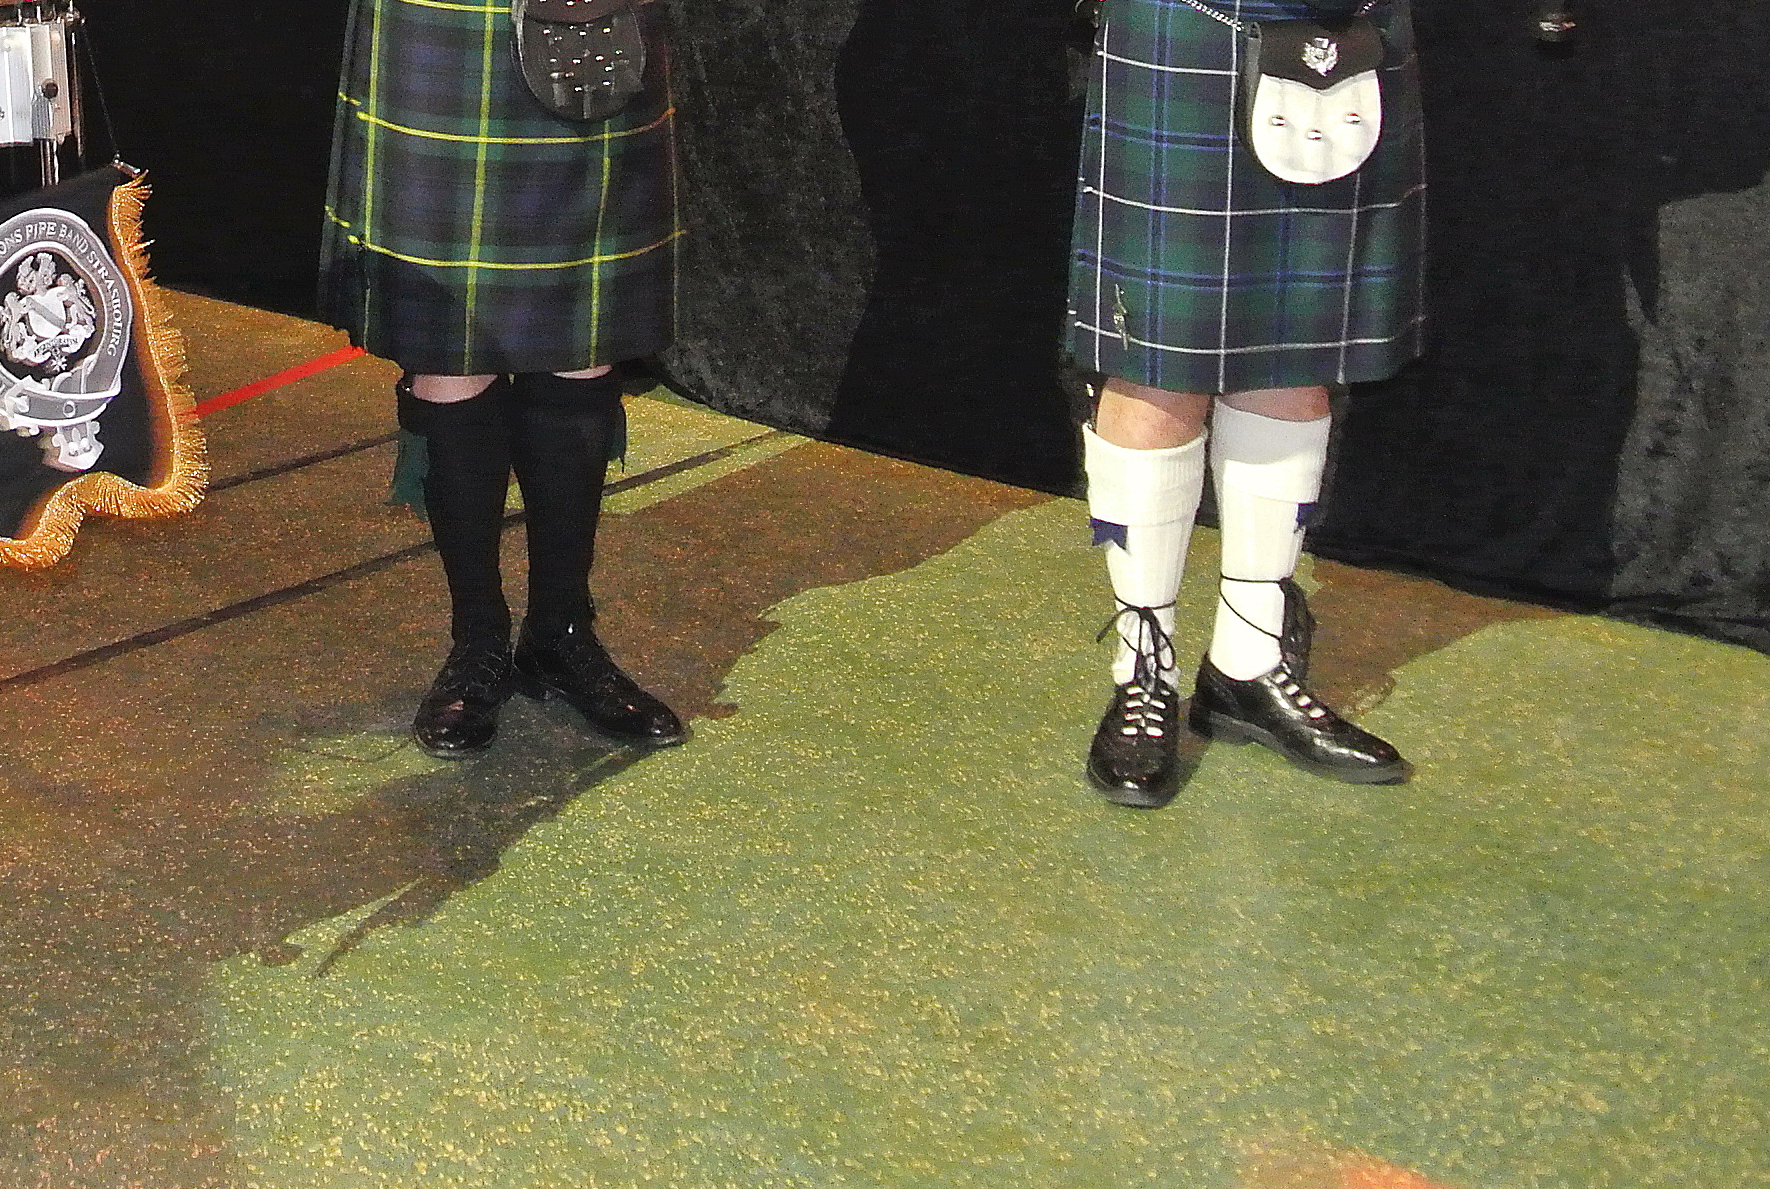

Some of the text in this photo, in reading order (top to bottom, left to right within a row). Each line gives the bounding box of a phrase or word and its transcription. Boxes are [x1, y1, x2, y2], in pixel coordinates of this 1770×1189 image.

[25, 221, 57, 242] PIPE
[58, 223, 89, 253] BAND
[87, 250, 123, 357] STRASBOURG
